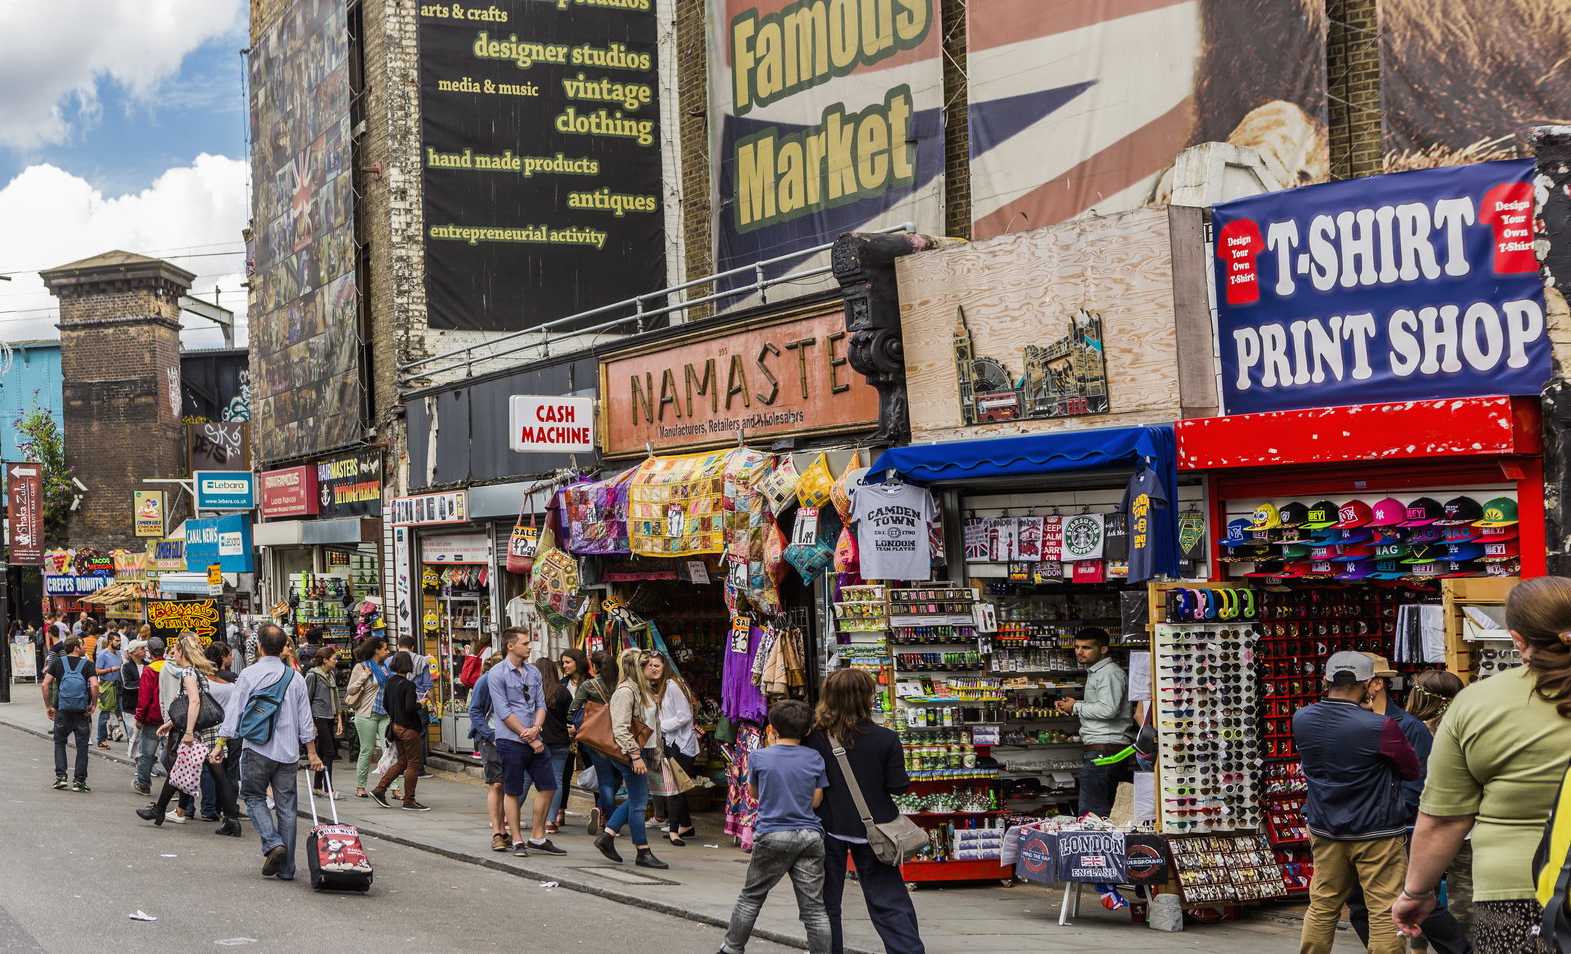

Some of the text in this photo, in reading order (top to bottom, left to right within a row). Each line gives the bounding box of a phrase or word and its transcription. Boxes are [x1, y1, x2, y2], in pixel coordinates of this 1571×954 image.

[420, 5, 508, 22] arts & crafts
[474, 33, 650, 69] designer studios
[734, 0, 927, 108] Famous
[438, 78, 538, 96] media & music
[564, 74, 650, 108] vintage
[556, 108, 652, 144] clothing
[428, 148, 598, 176] hand made products
[738, 95, 912, 225] Market
[568, 189, 655, 214] antiques
[1496, 200, 1530, 212] Design
[1502, 214, 1526, 224] Your
[430, 225, 606, 247] entrepreneurial activity
[1503, 227, 1528, 238] Own
[1228, 235, 1251, 248] Design
[1268, 196, 1474, 296] T-SHIRT
[1499, 240, 1534, 252] T-Shirt
[1232, 248, 1248, 258] Your
[1233, 260, 1250, 272] Own
[1230, 273, 1254, 285] T-Shirt
[1233, 300, 1544, 390] PRINT SHOP
[630, 331, 850, 425] NAMASTE
[536, 405, 574, 423] CASH
[521, 426, 590, 445] MACHINE
[659, 421, 708, 438] Manufacturers,
[708, 417, 740, 434] Retailers
[14, 483, 28, 534] Shaka Zulu
[868, 506, 921, 520] CAMDEN
[874, 516, 916, 527] TOWN
[1067, 518, 1100, 536] STARSUCKS
[187, 528, 218, 544] CANAL NEWS
[514, 528, 536, 536] SALE
[1070, 544, 1094, 554] COFFEE
[47, 576, 74, 592] CREPES
[165, 619, 210, 628] TATTOO
[736, 619, 749, 627] SAL
[1060, 834, 1125, 856] LONDON
[1072, 868, 1117, 877] ENGLAND
